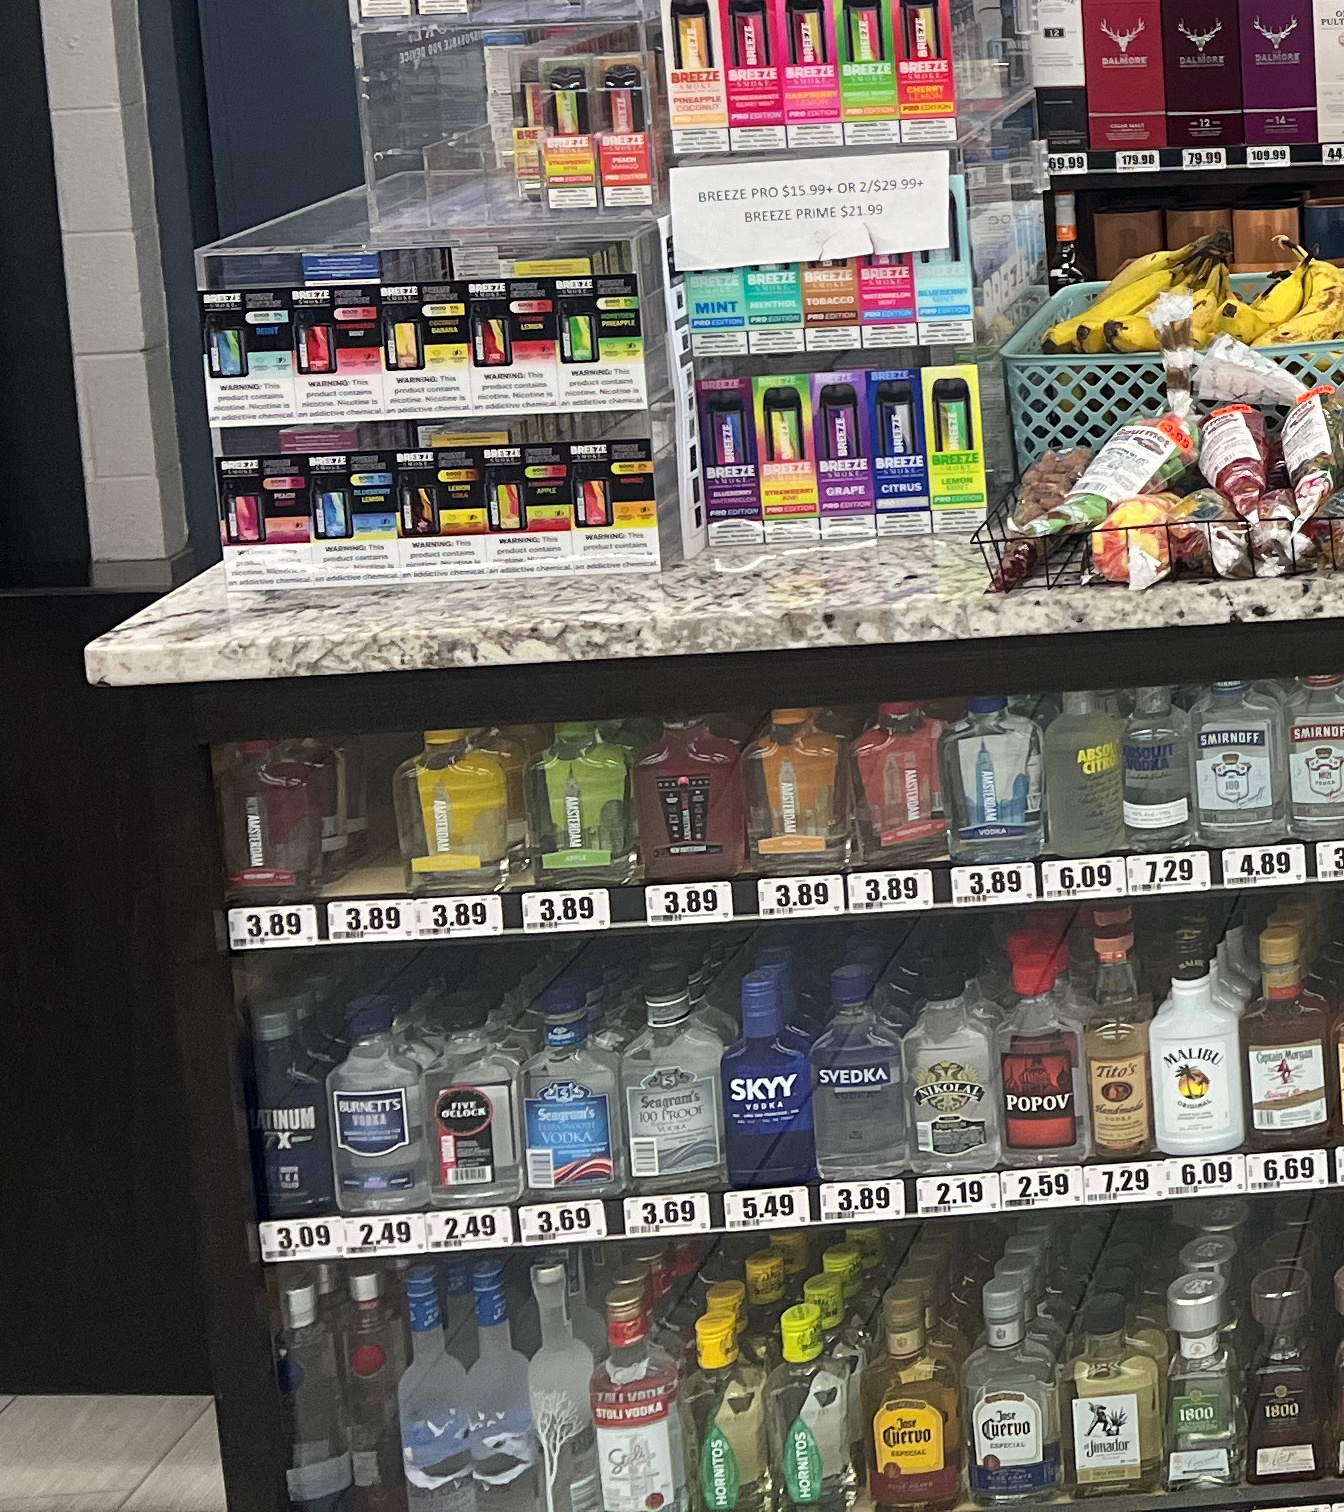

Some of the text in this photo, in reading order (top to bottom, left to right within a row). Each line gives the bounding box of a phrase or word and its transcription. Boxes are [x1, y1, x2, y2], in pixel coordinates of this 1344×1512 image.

[843, 62, 892, 76] BREEZE
[1102, 56, 1147, 66] DALMORE
[698, 178, 924, 203] BREEZE PRO $15.99+ OR 2/$29.99+
[744, 204, 884, 223] BREEZE PRIME $21.99
[556, 279, 593, 291] BREEZE
[695, 300, 738, 315] MINT
[571, 445, 607, 456] BREEZE
[875, 455, 924, 469] BREEZE
[826, 485, 865, 496] GRAPE
[881, 482, 923, 493] CITRUS
[565, 796, 582, 848] AMSTERDAM
[1145, 858, 1194, 882] 7.29
[1239, 850, 1292, 875] 4.89
[539, 895, 595, 921] 3.89
[664, 889, 718, 914] 3.89
[1163, 1048, 1222, 1068] MALIBU
[819, 1068, 888, 1085] SVEDKA
[1006, 1093, 1072, 1112] POPOV
[541, 1129, 593, 1144] VODKA
[1263, 1156, 1315, 1182] 6.69
[937, 1180, 984, 1205] 2.19
[742, 1194, 794, 1219] 5.49
[445, 1214, 497, 1240] 2.49
[537, 1207, 591, 1232] 3.69
[277, 1224, 331, 1248] 3.09
[1178, 1407, 1213, 1420] 1800
[1264, 1403, 1299, 1419] 1800
[981, 1419, 1031, 1440] Cuervo
